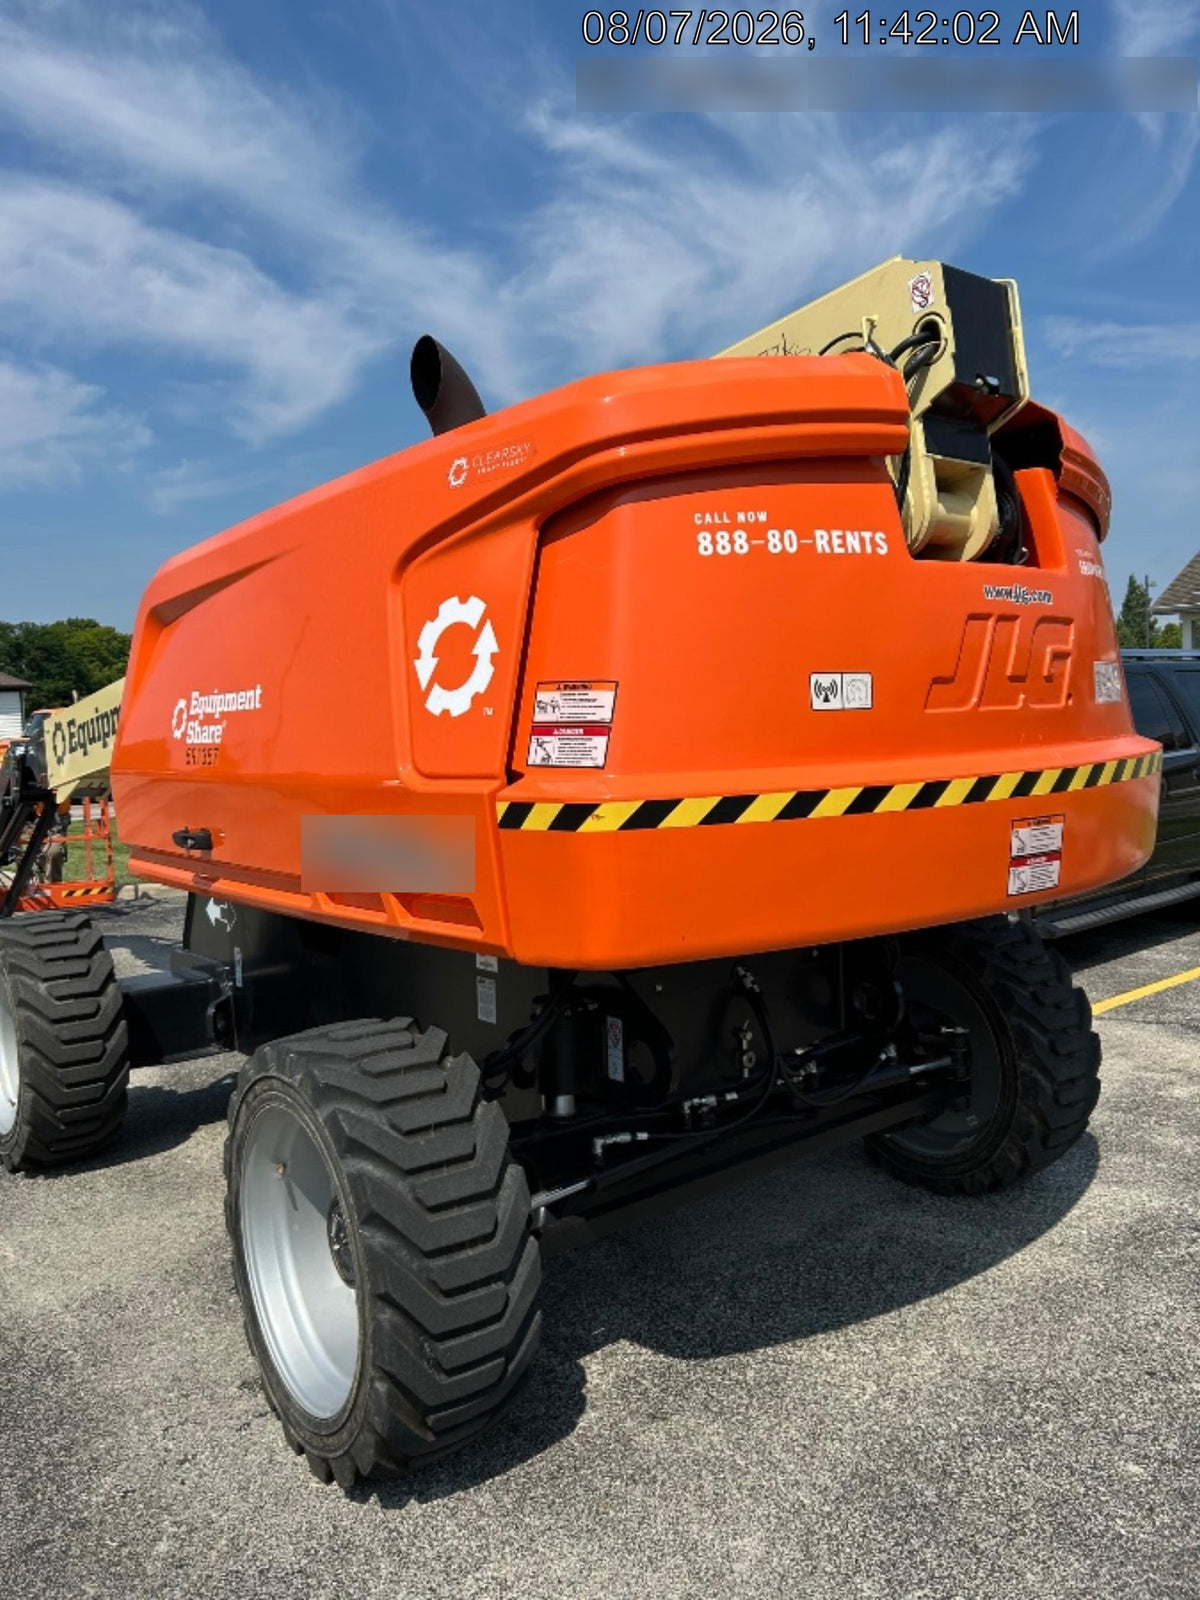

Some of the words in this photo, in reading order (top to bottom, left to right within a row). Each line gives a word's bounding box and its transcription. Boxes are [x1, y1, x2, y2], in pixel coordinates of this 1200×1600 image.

[694, 512, 732, 525] CALL
[736, 511, 768, 524] NOW
[696, 528, 889, 556] 888-80-RENTS
[983, 583, 1054, 606] www.jlg.com
[924, 612, 1076, 714] JLG
[188, 683, 263, 721] Equipment
[185, 720, 224, 745] Share
